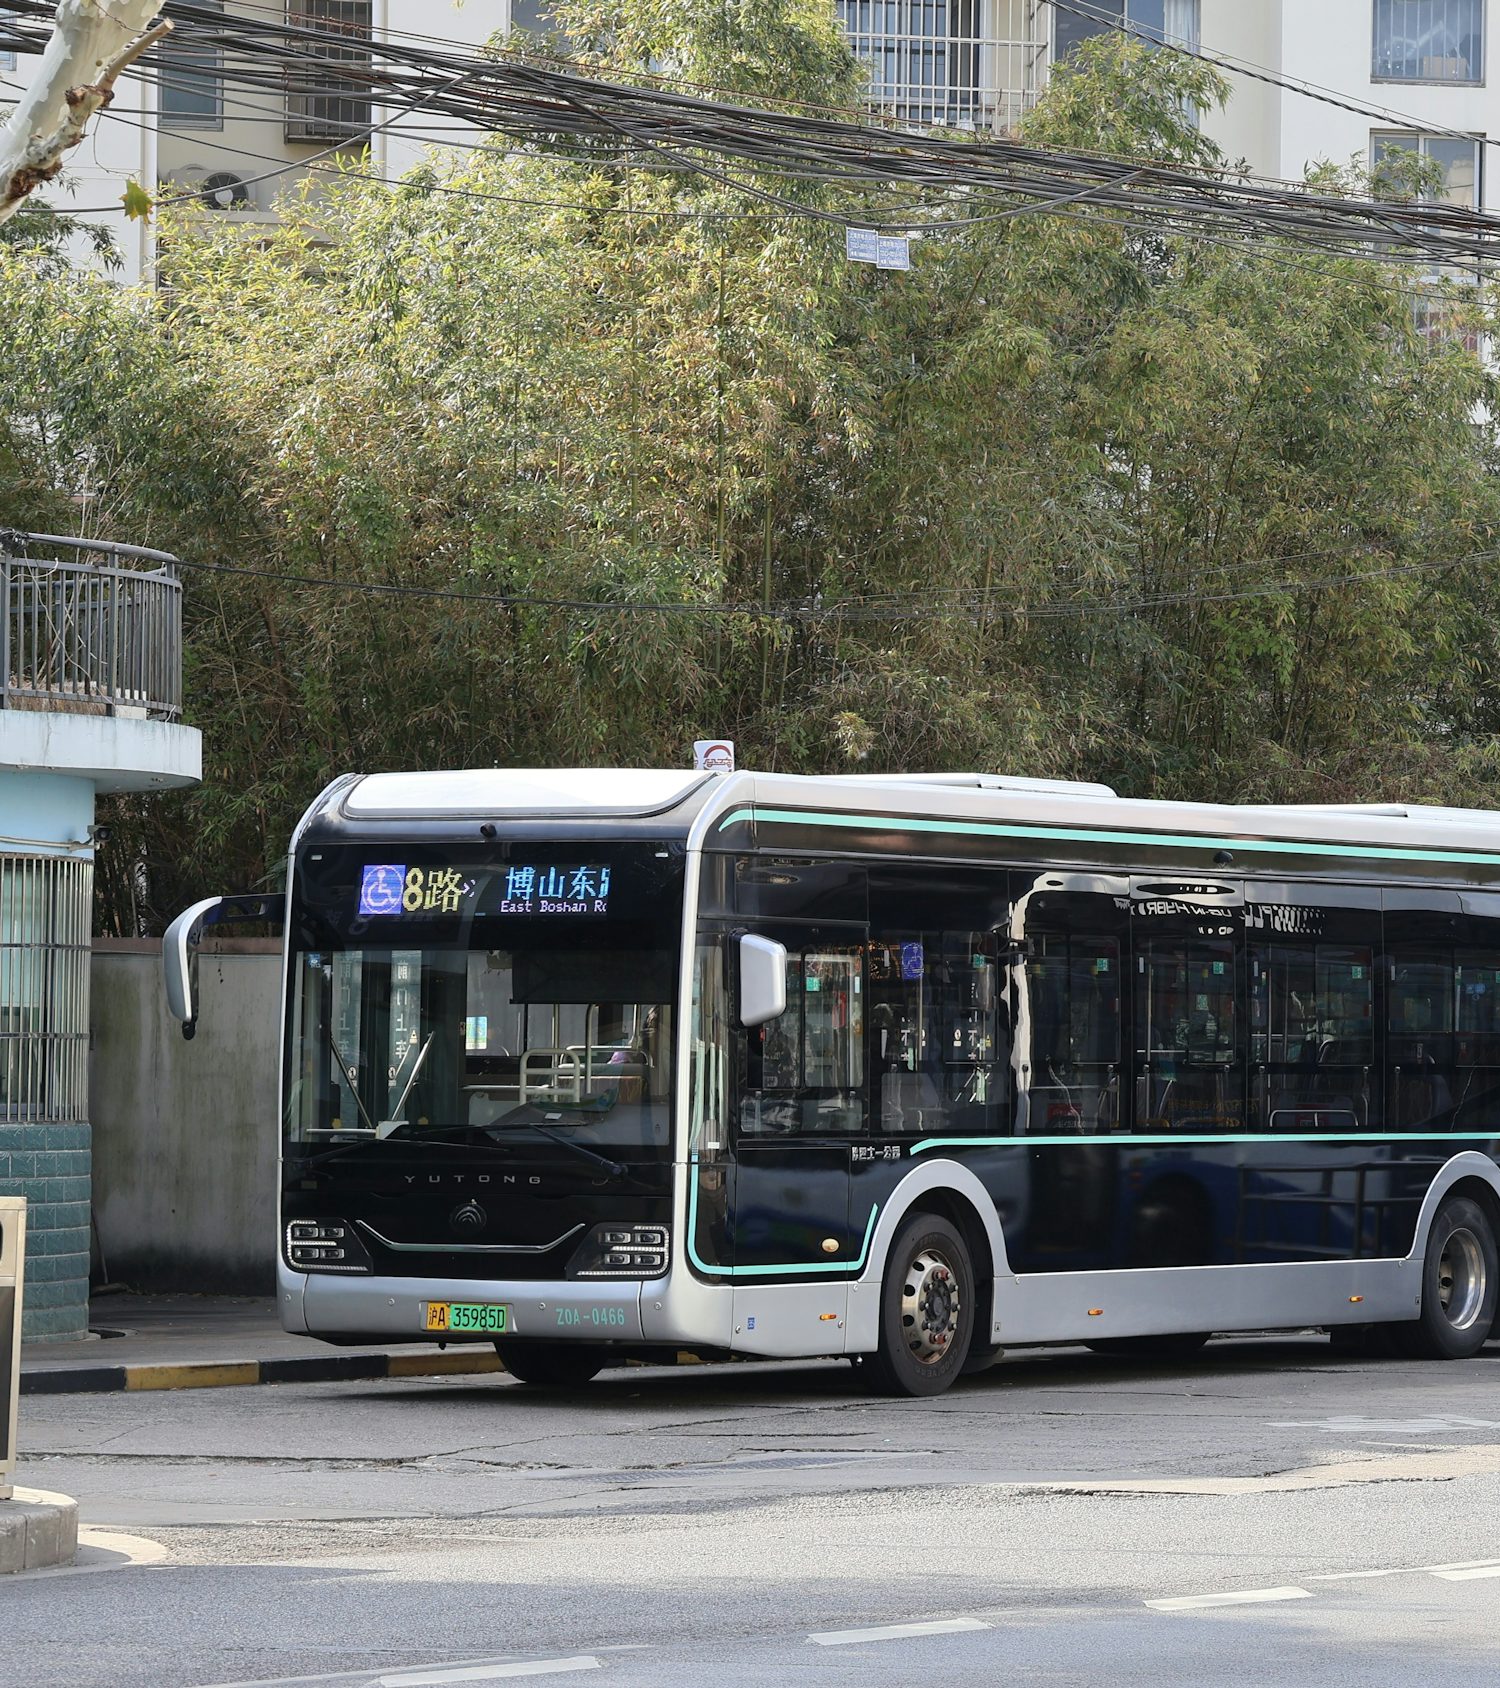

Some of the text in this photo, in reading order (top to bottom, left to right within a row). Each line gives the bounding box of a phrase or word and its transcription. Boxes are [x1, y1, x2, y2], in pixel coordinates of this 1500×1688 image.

[402, 867, 463, 912] 8路
[500, 901, 532, 912] East
[540, 901, 587, 912] Boshan
[404, 1175, 541, 1184] YUTONG
